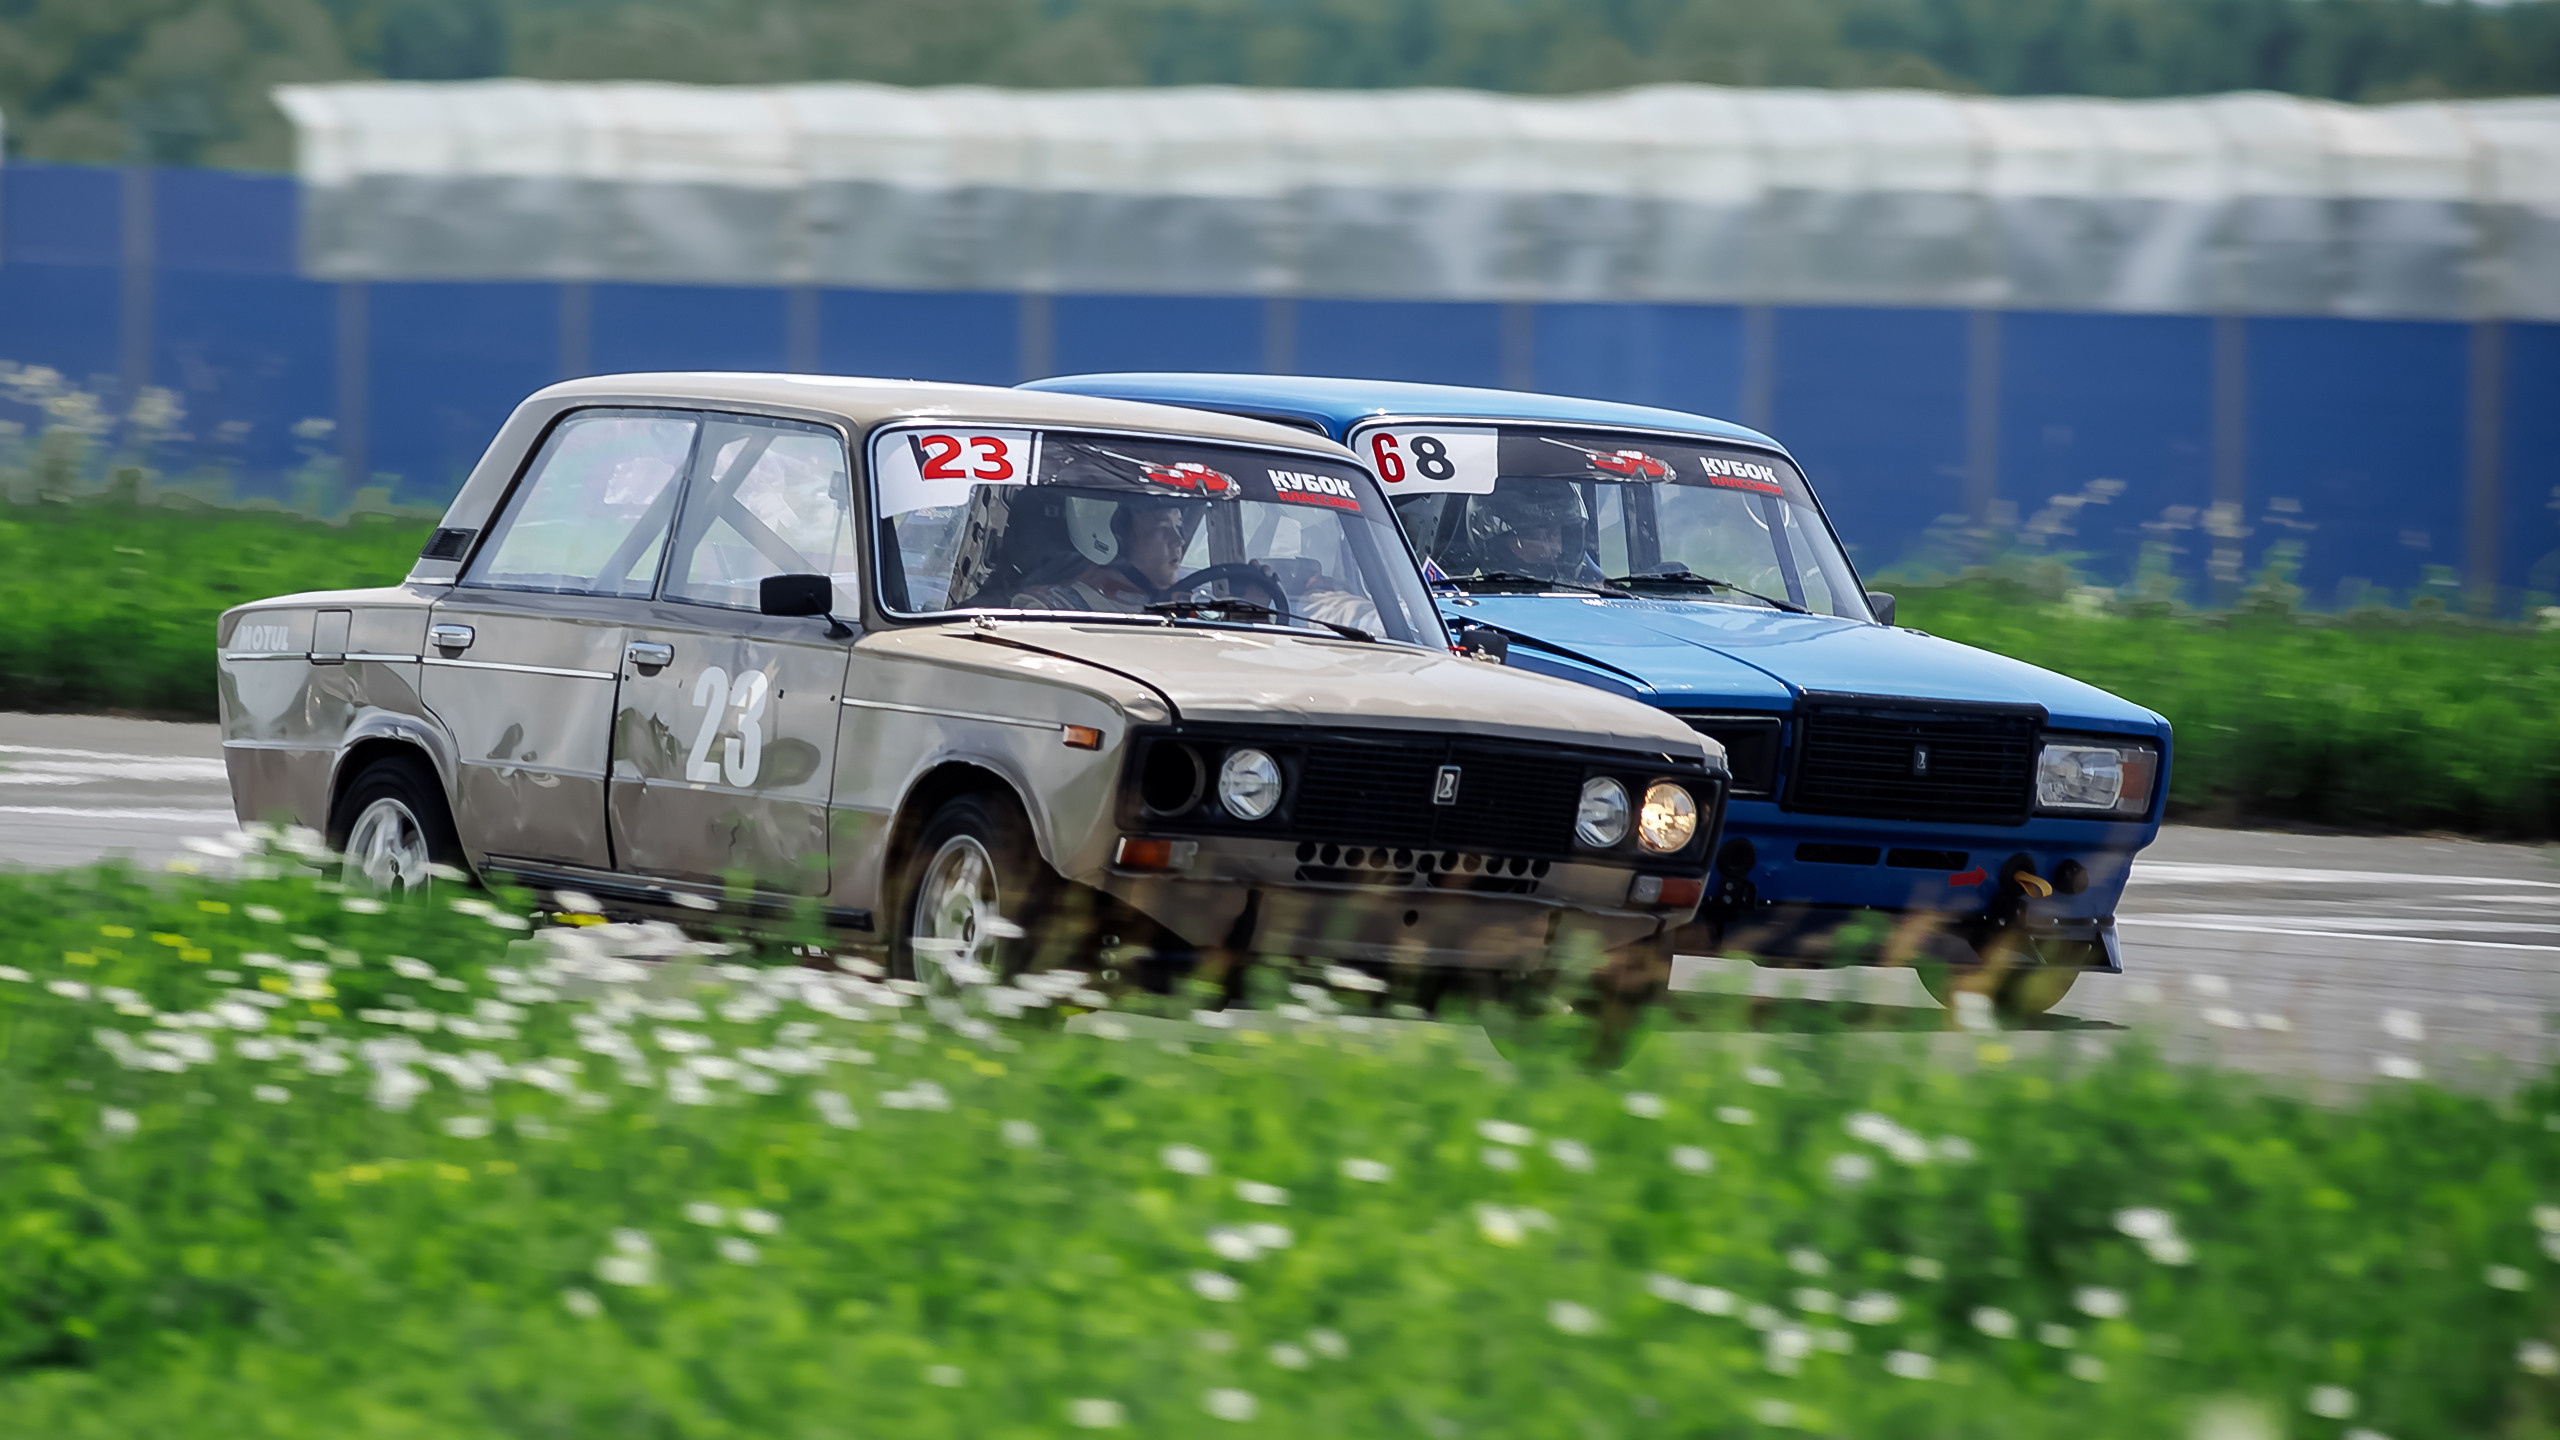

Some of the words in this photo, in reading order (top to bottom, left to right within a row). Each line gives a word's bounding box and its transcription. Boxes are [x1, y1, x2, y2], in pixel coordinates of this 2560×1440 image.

[920, 434, 1014, 481] 23
[1371, 433, 1456, 483] 68
[1699, 456, 1778, 484] КУБОК
[1267, 469, 1356, 499] КУБОК
[238, 624, 289, 652] MOTUL
[685, 665, 769, 788] 23
